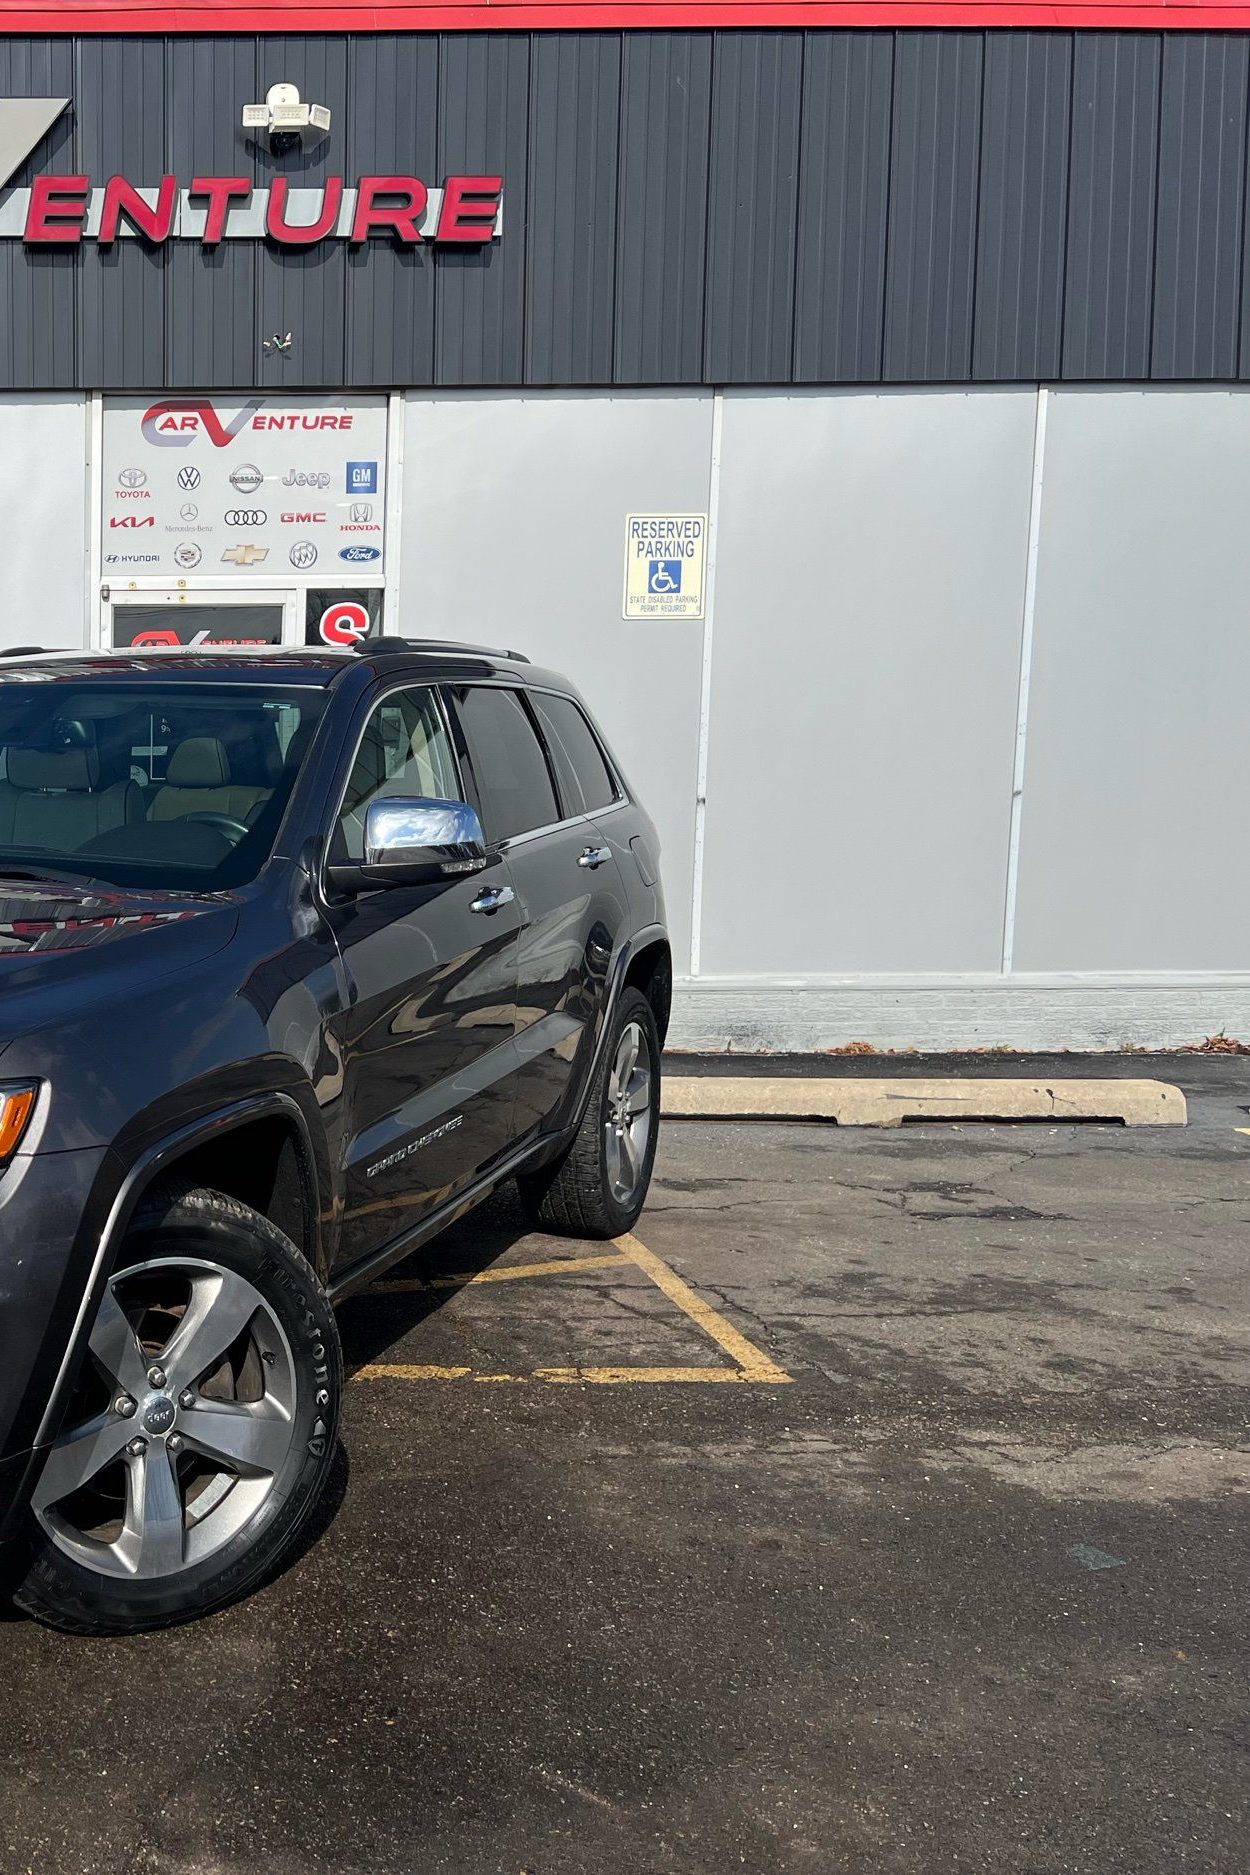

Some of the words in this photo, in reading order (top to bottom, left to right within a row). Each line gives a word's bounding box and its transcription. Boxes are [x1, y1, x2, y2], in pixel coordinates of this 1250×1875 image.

[282, 468, 331, 489] Jeep
[352, 468, 371, 482] GM
[115, 491, 151, 499] TOYOTA
[280, 512, 327, 523] GMC
[631, 521, 701, 539] RESERVED
[346, 548, 374, 560] Ford
[637, 540, 695, 558] PARKING
[629, 596, 646, 604] STATE
[648, 596, 674, 604] DISABLED
[675, 596, 698, 604] PARKING
[640, 605, 658, 613] PERMIT
[661, 605, 687, 613] REQUIRED
